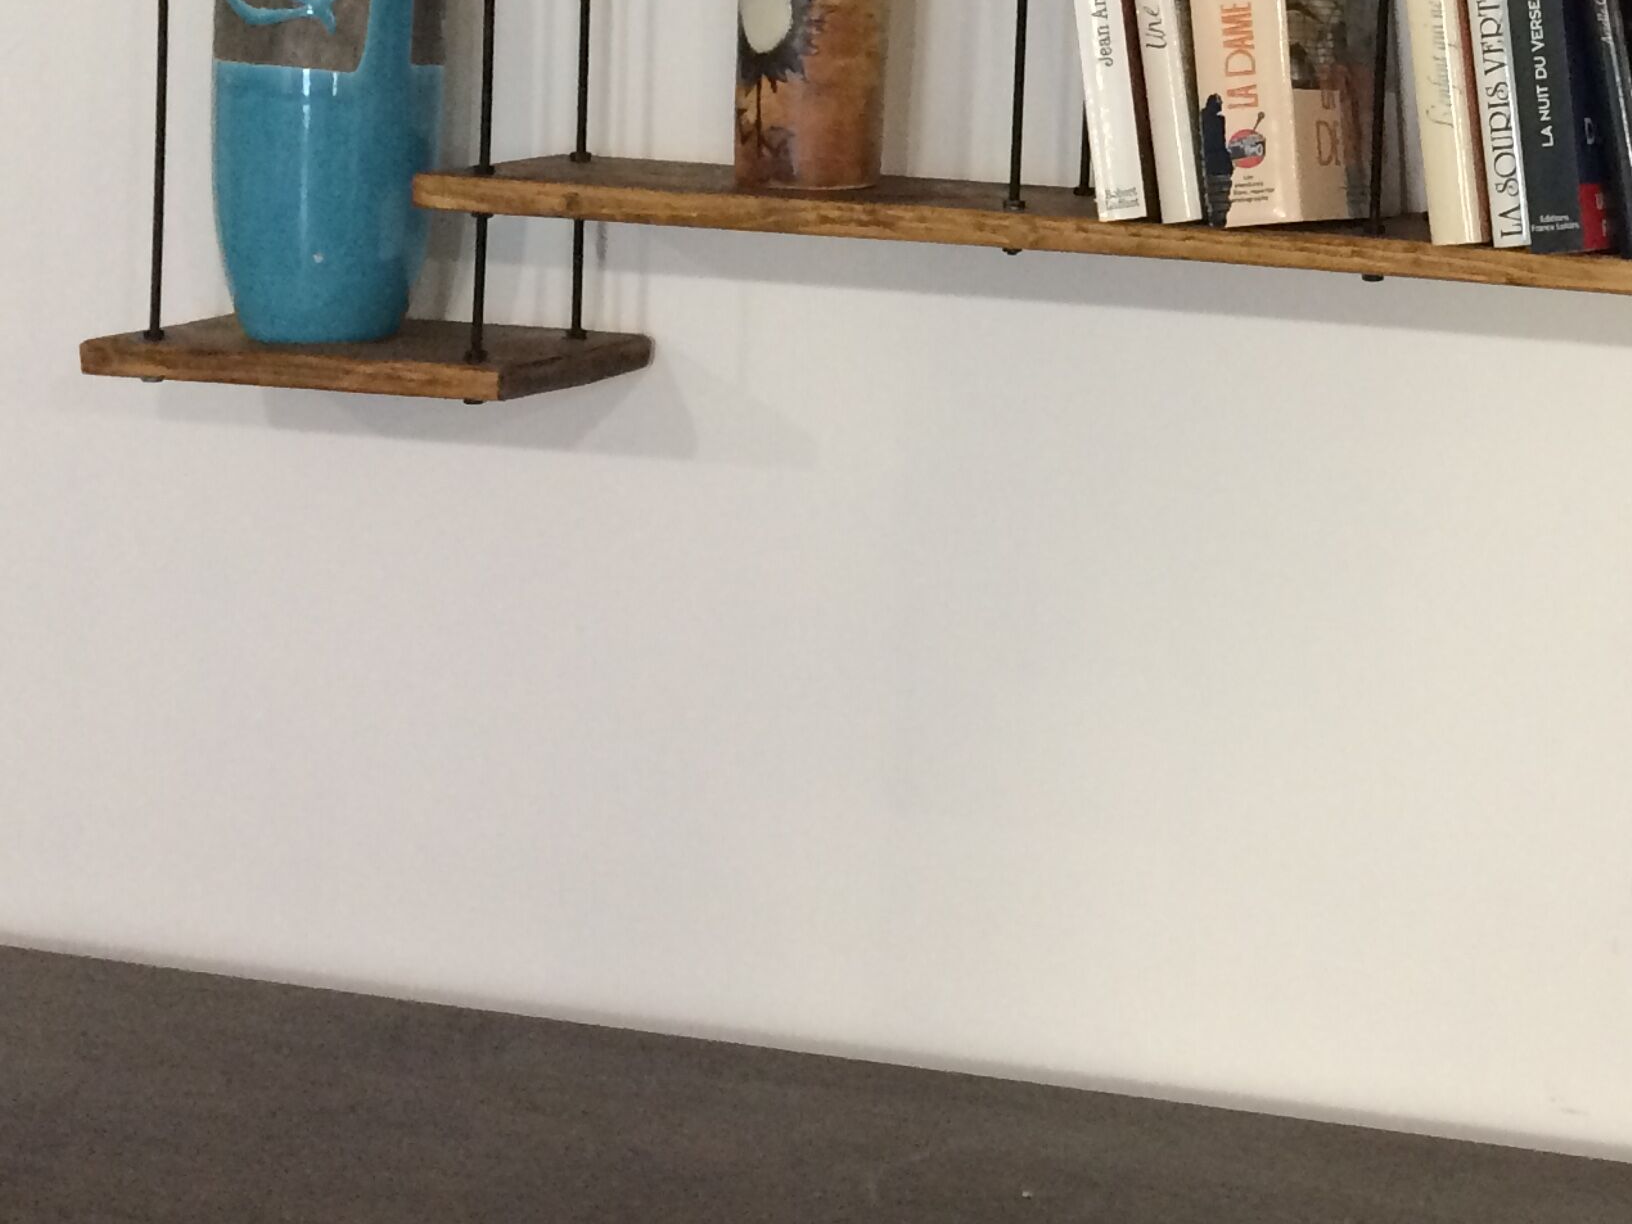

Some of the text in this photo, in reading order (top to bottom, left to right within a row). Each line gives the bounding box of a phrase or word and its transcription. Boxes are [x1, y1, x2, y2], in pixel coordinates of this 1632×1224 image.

[1096, 24, 1114, 68] Jean
[1144, 9, 1167, 49] Une
[1220, 2, 1257, 78] DAME
[1533, 55, 1548, 79] DU
[1226, 84, 1259, 110] LA
[1535, 84, 1552, 121] NUIT
[1484, 81, 1520, 197] SOURIS
[1540, 125, 1554, 146] LA
[1497, 204, 1523, 238] LA
